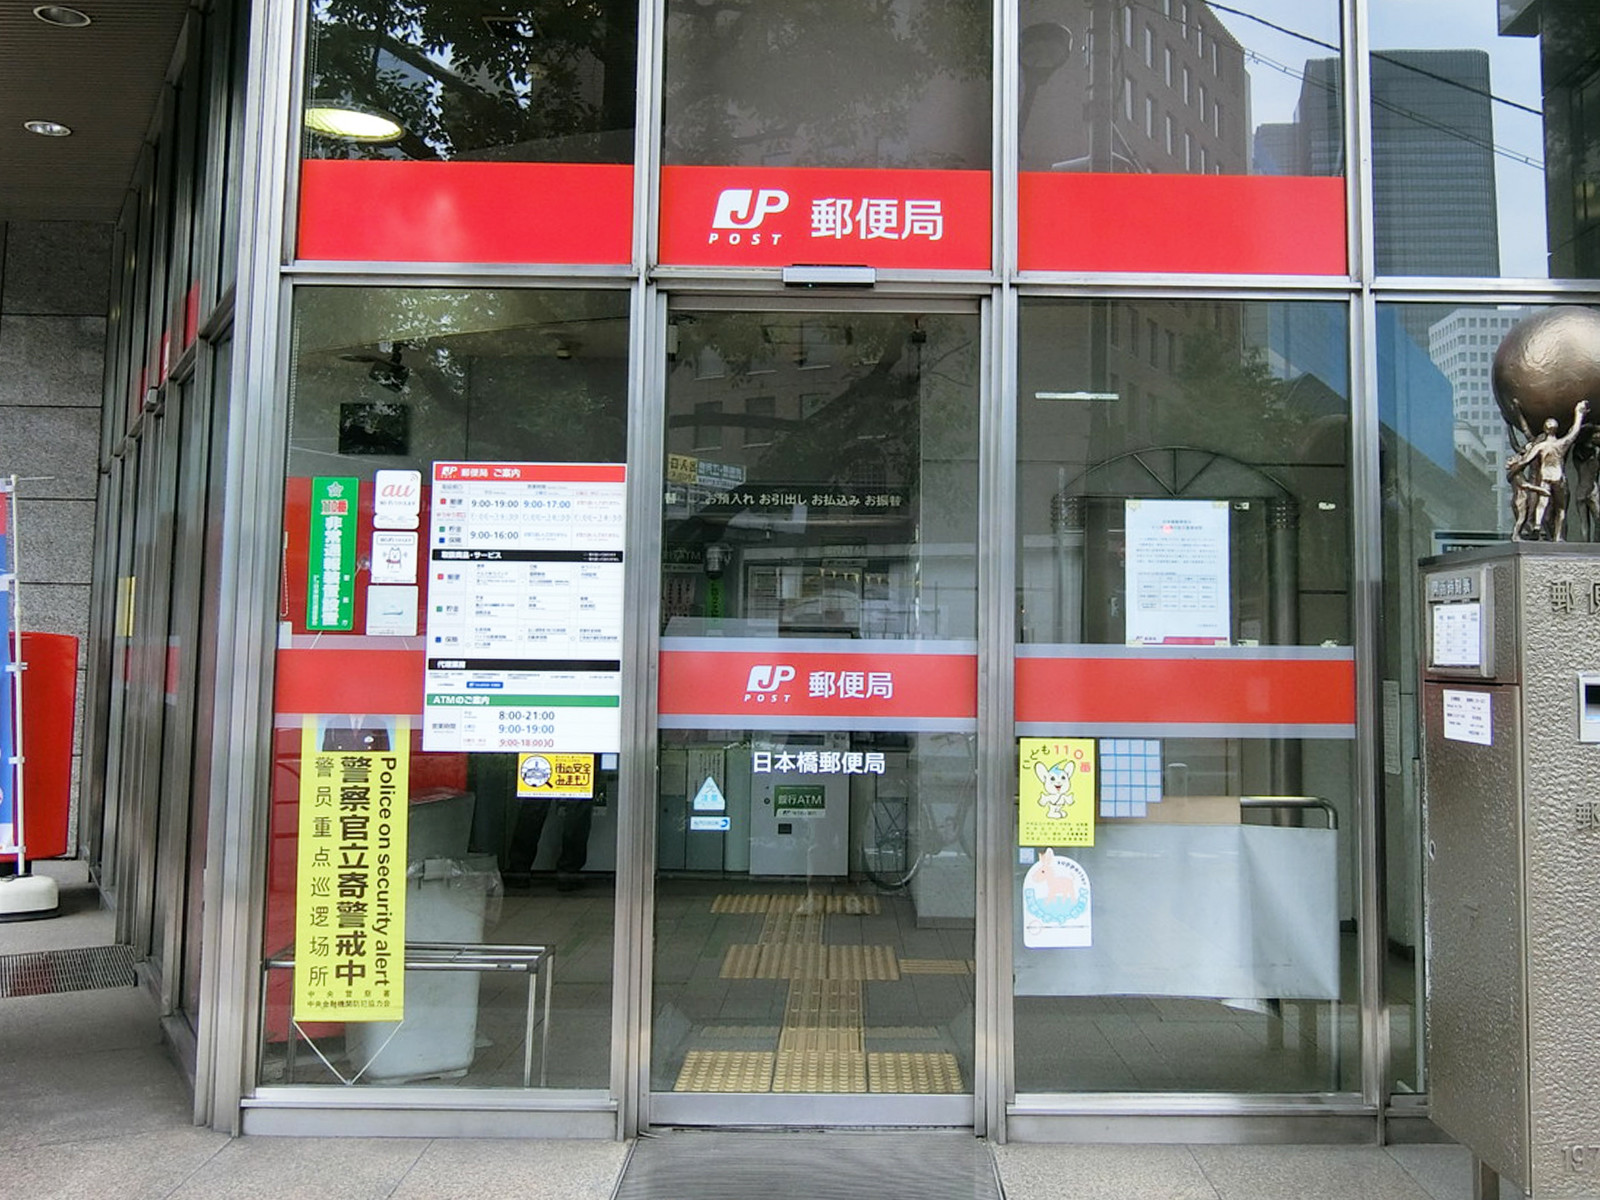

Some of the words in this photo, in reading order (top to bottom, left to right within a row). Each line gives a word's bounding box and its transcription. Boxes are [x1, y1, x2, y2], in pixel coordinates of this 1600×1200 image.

[711, 188, 790, 229] JP
[811, 198, 944, 241] 郵便局
[708, 233, 782, 246] POST
[493, 468, 521, 478] ご案内
[381, 483, 415, 498] au
[705, 493, 755, 506] お預入れ
[759, 493, 807, 506] お引出し
[811, 493, 861, 506] お払込み
[470, 530, 519, 540] 9:00-16:00
[746, 664, 796, 692] JP
[808, 671, 894, 700] 郵便局
[432, 695, 490, 705] ATMのご案内
[743, 694, 791, 703] POST
[498, 711, 555, 720] 8:00-21:00
[498, 724, 555, 734] 9:00-19:00
[753, 751, 886, 774] 日本橋郵便局
[377, 757, 397, 818] Police
[376, 822, 391, 850] on
[307, 755, 335, 987] 警员重点巡逻场所
[335, 756, 372, 987] 警察官立寄警戒中
[372, 854, 392, 936] security
[374, 940, 391, 987] alert
